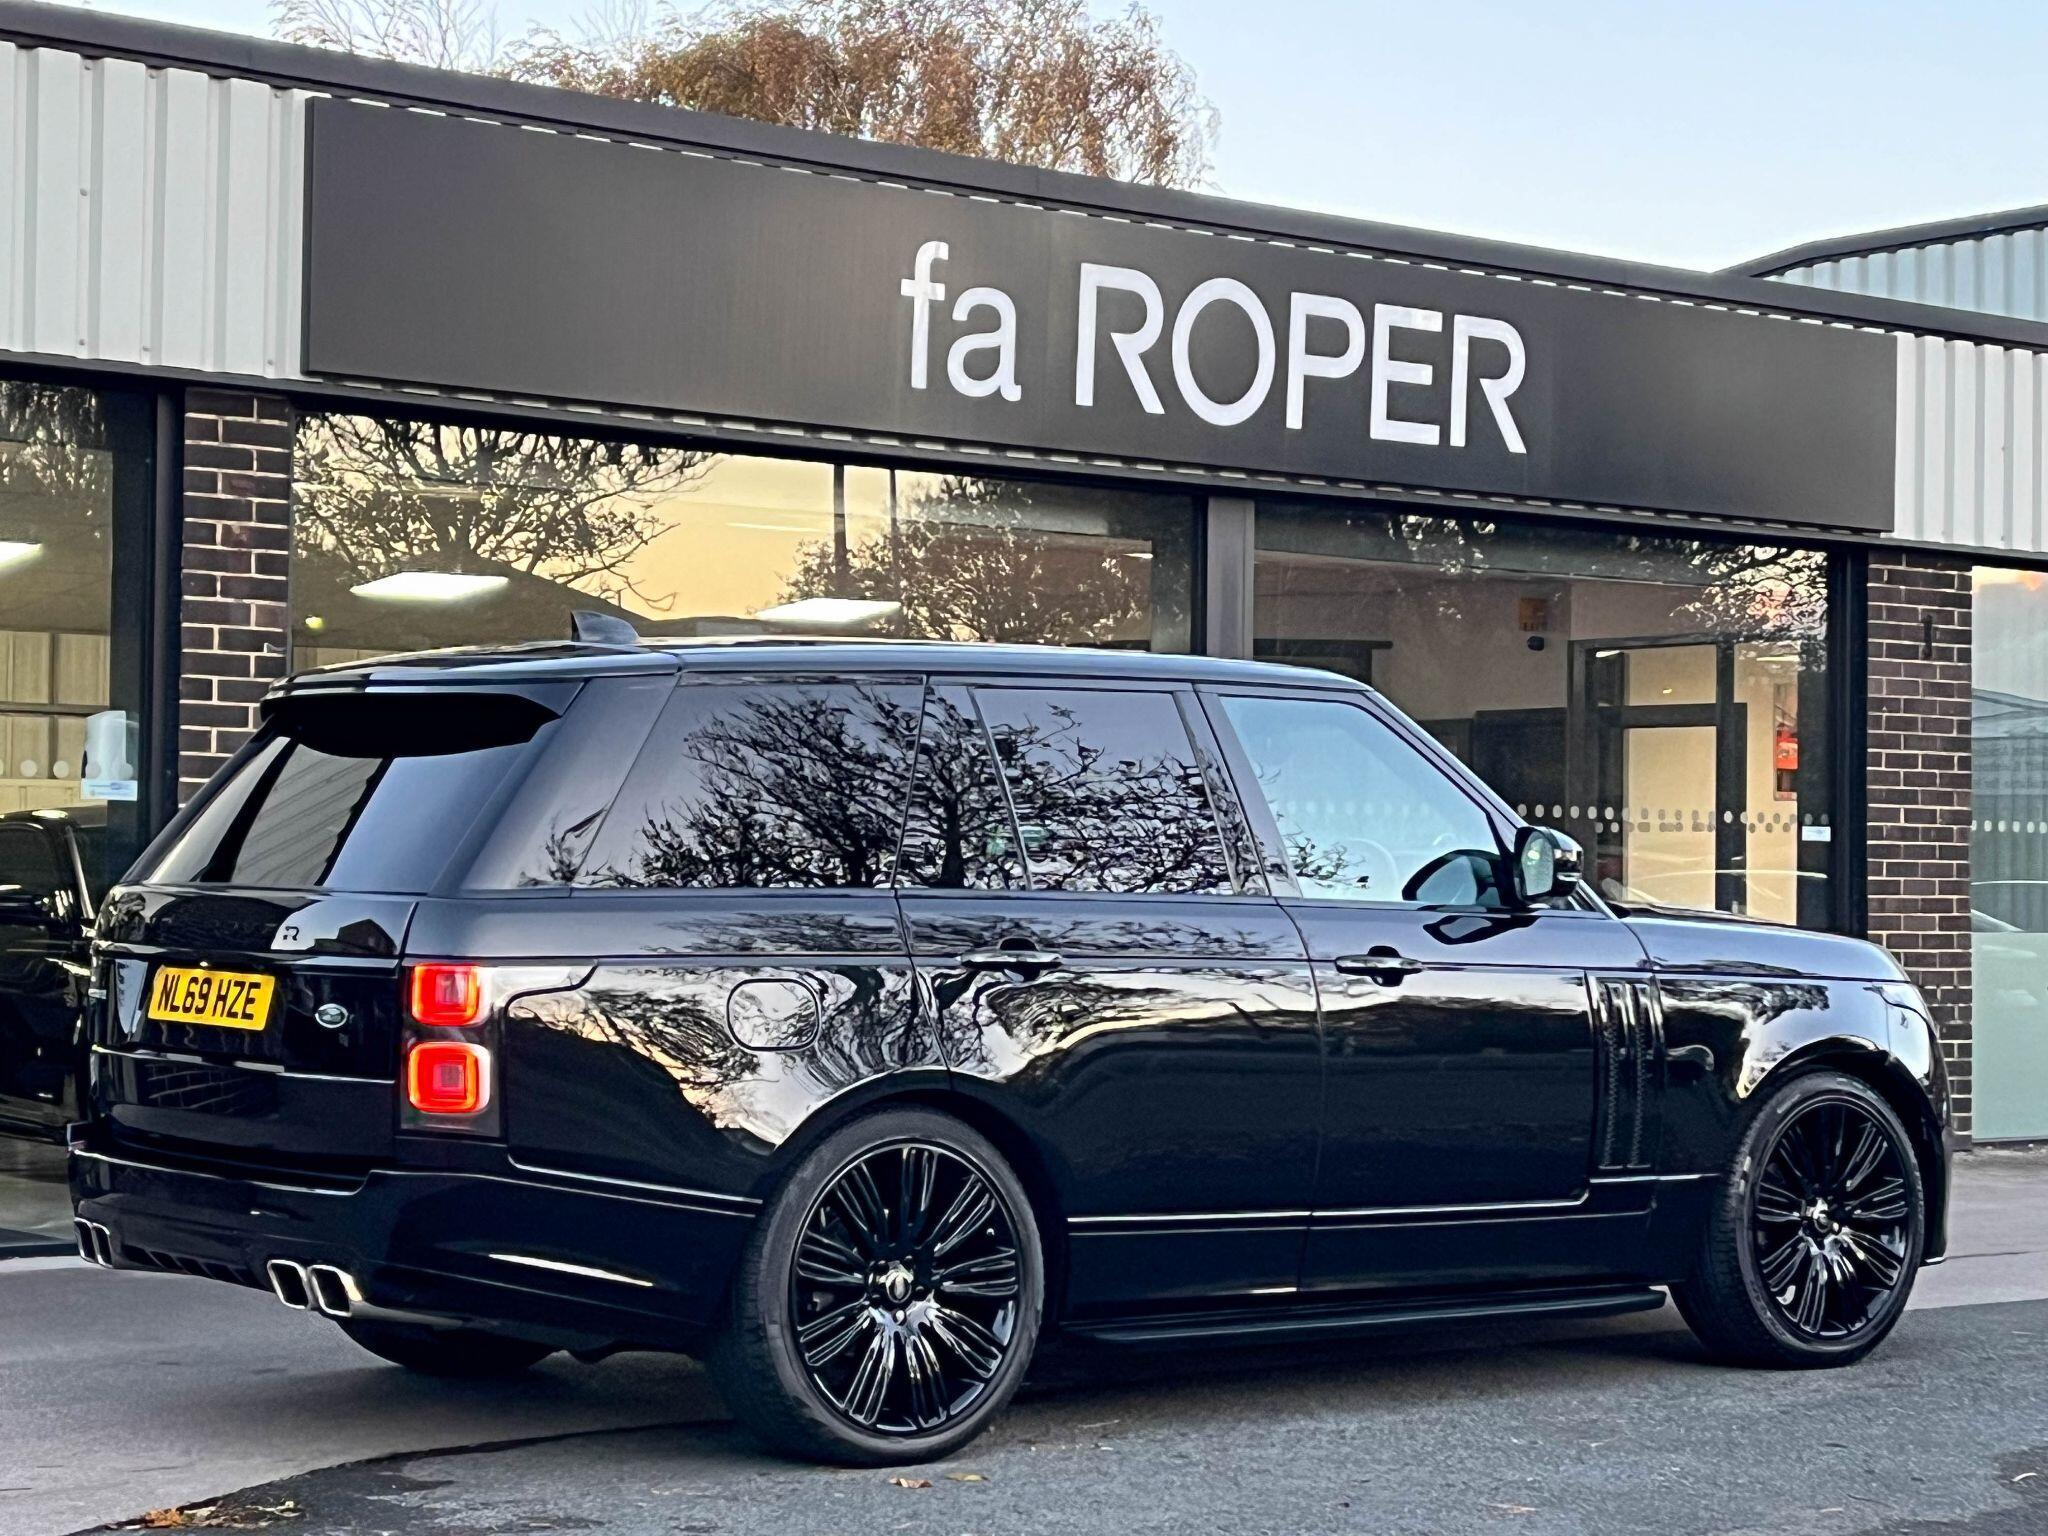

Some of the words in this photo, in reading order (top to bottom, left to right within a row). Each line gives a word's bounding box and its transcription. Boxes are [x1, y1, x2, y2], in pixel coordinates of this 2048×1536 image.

[900, 241, 1022, 402] fa
[1075, 263, 1527, 454] ROPER
[157, 973, 213, 1015] NL69
[211, 978, 262, 1021] HZE
